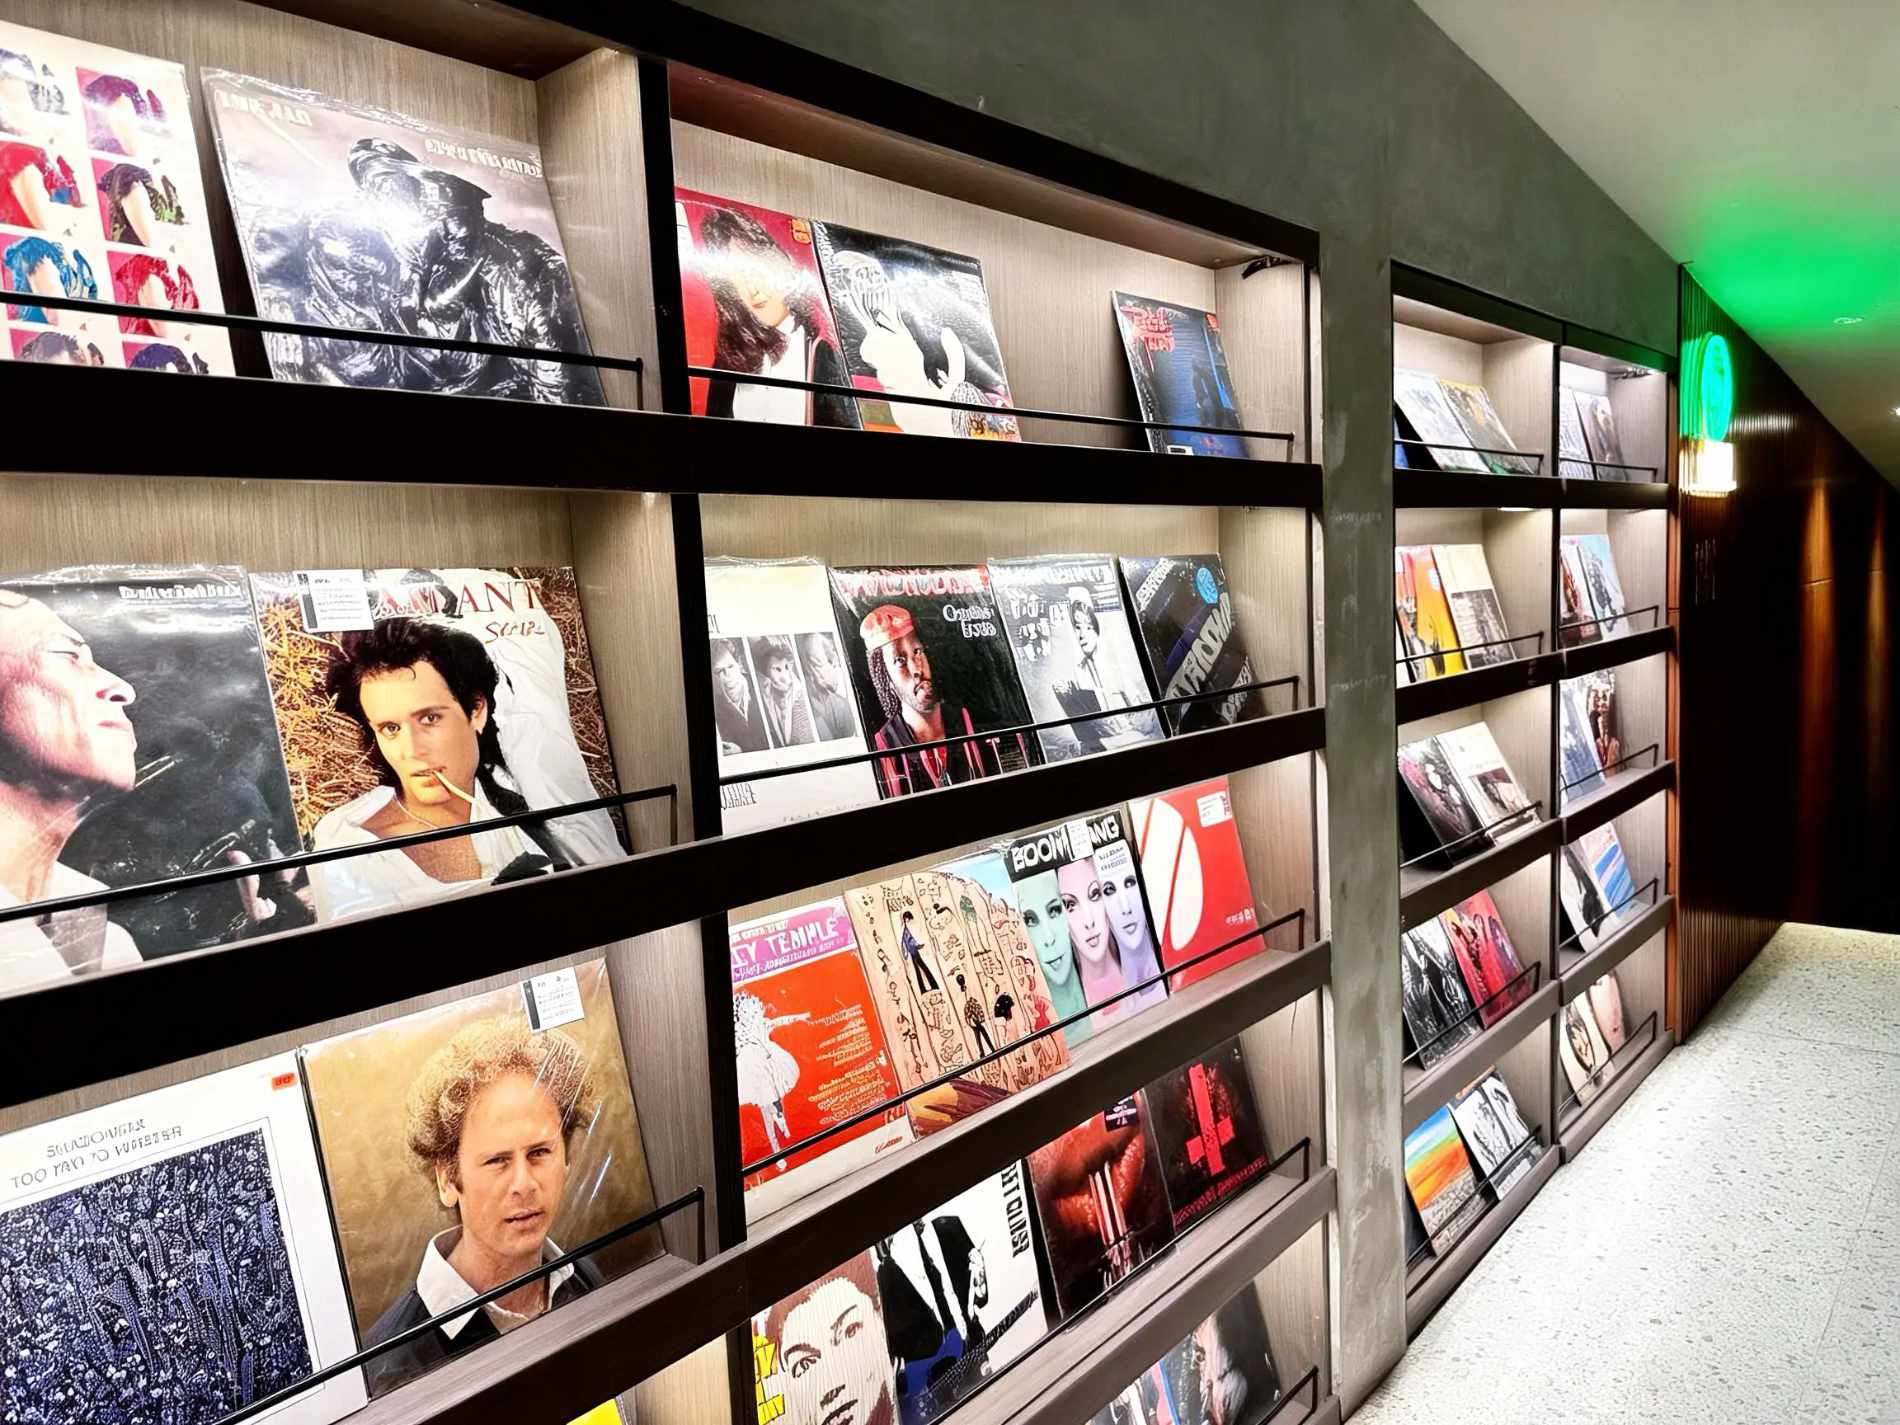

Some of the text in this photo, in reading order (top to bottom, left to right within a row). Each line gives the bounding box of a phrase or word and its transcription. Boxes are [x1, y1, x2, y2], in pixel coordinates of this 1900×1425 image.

[456, 579, 541, 616] ANT
[764, 917, 840, 957] TEMPLE
[9, 1166, 47, 1189] TOO
